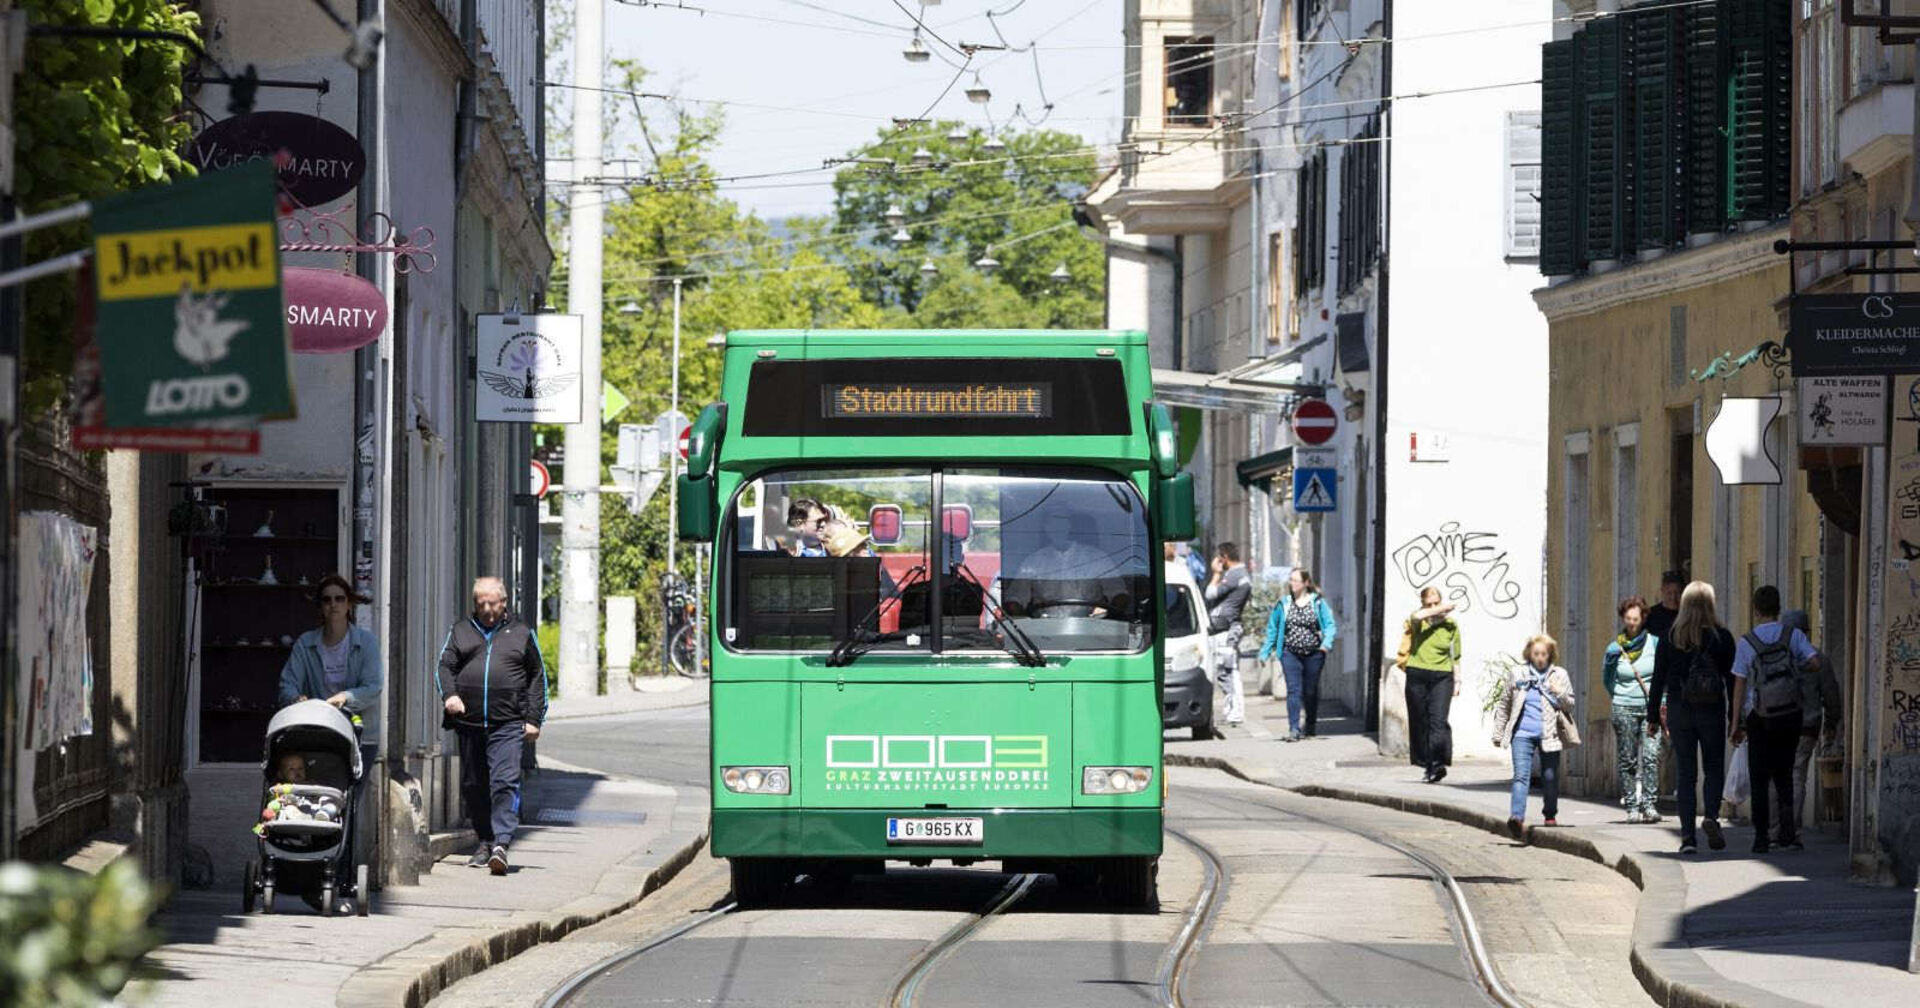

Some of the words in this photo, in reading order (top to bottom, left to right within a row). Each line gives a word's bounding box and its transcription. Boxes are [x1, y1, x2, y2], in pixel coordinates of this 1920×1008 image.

[109, 234, 262, 286] Jackpot
[1862, 295, 1894, 318] CS
[145, 373, 250, 417] LOTTO
[1813, 379, 1838, 387] ALTE
[1840, 378, 1881, 387] WAFFEN
[841, 384, 1037, 413] Stadtrundfahrt
[826, 770, 872, 782] GRAZ
[877, 770, 1048, 782] ZWEITAUSENDDREI
